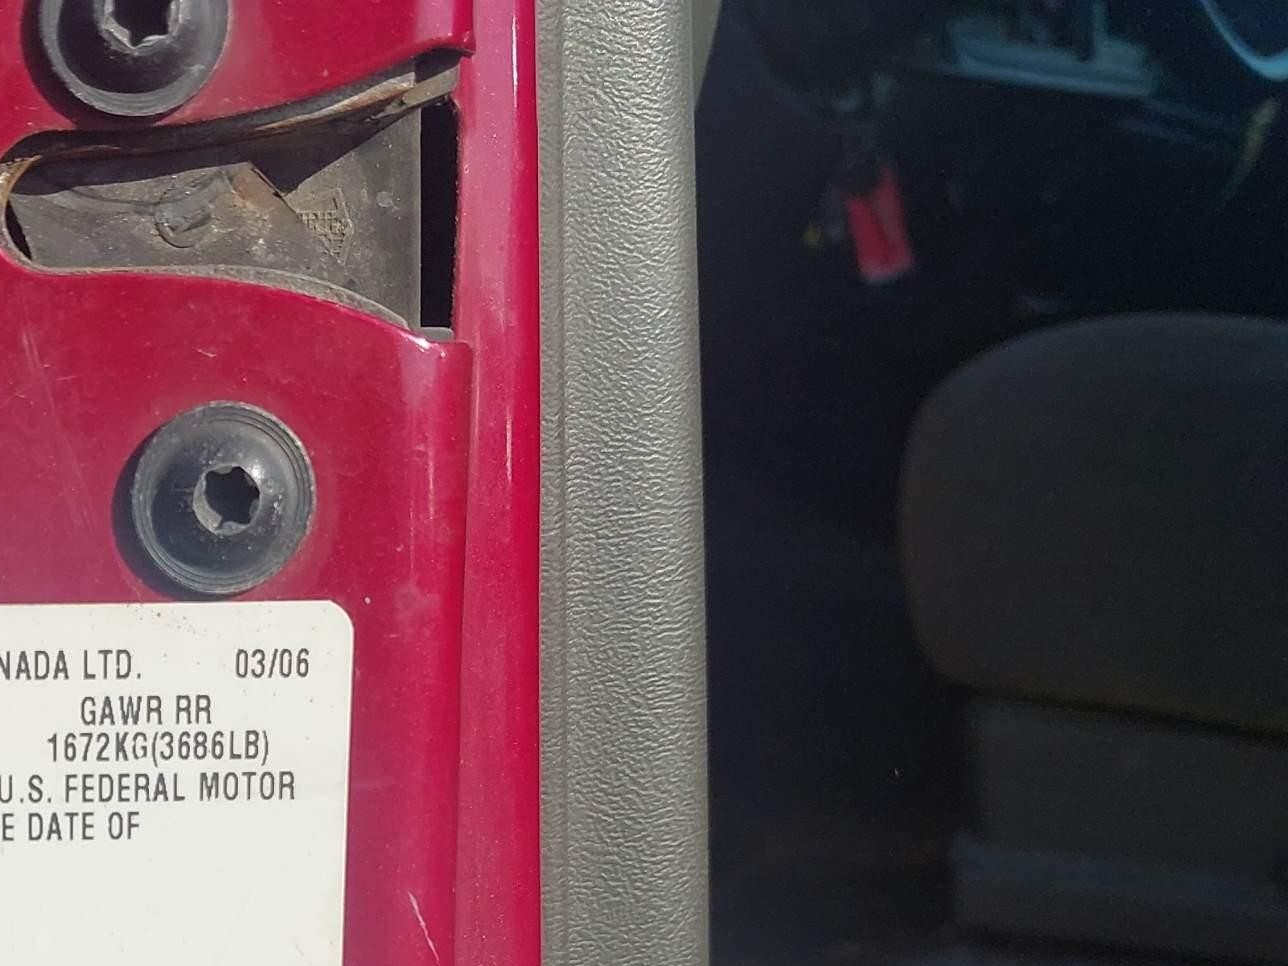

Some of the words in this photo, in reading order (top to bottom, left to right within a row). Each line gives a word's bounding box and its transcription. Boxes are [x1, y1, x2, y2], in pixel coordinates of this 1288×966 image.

[84, 649, 141, 680] LTD.
[236, 648, 309, 678] 03/06
[81, 695, 163, 726] GAWR
[176, 694, 212, 725] RR
[47, 730, 269, 768] 1672KG(3686LB)
[65, 773, 185, 803] FEDERAL
[200, 771, 295, 801] MOTOR
[28, 812, 94, 841] DATE
[108, 811, 139, 840] OF
